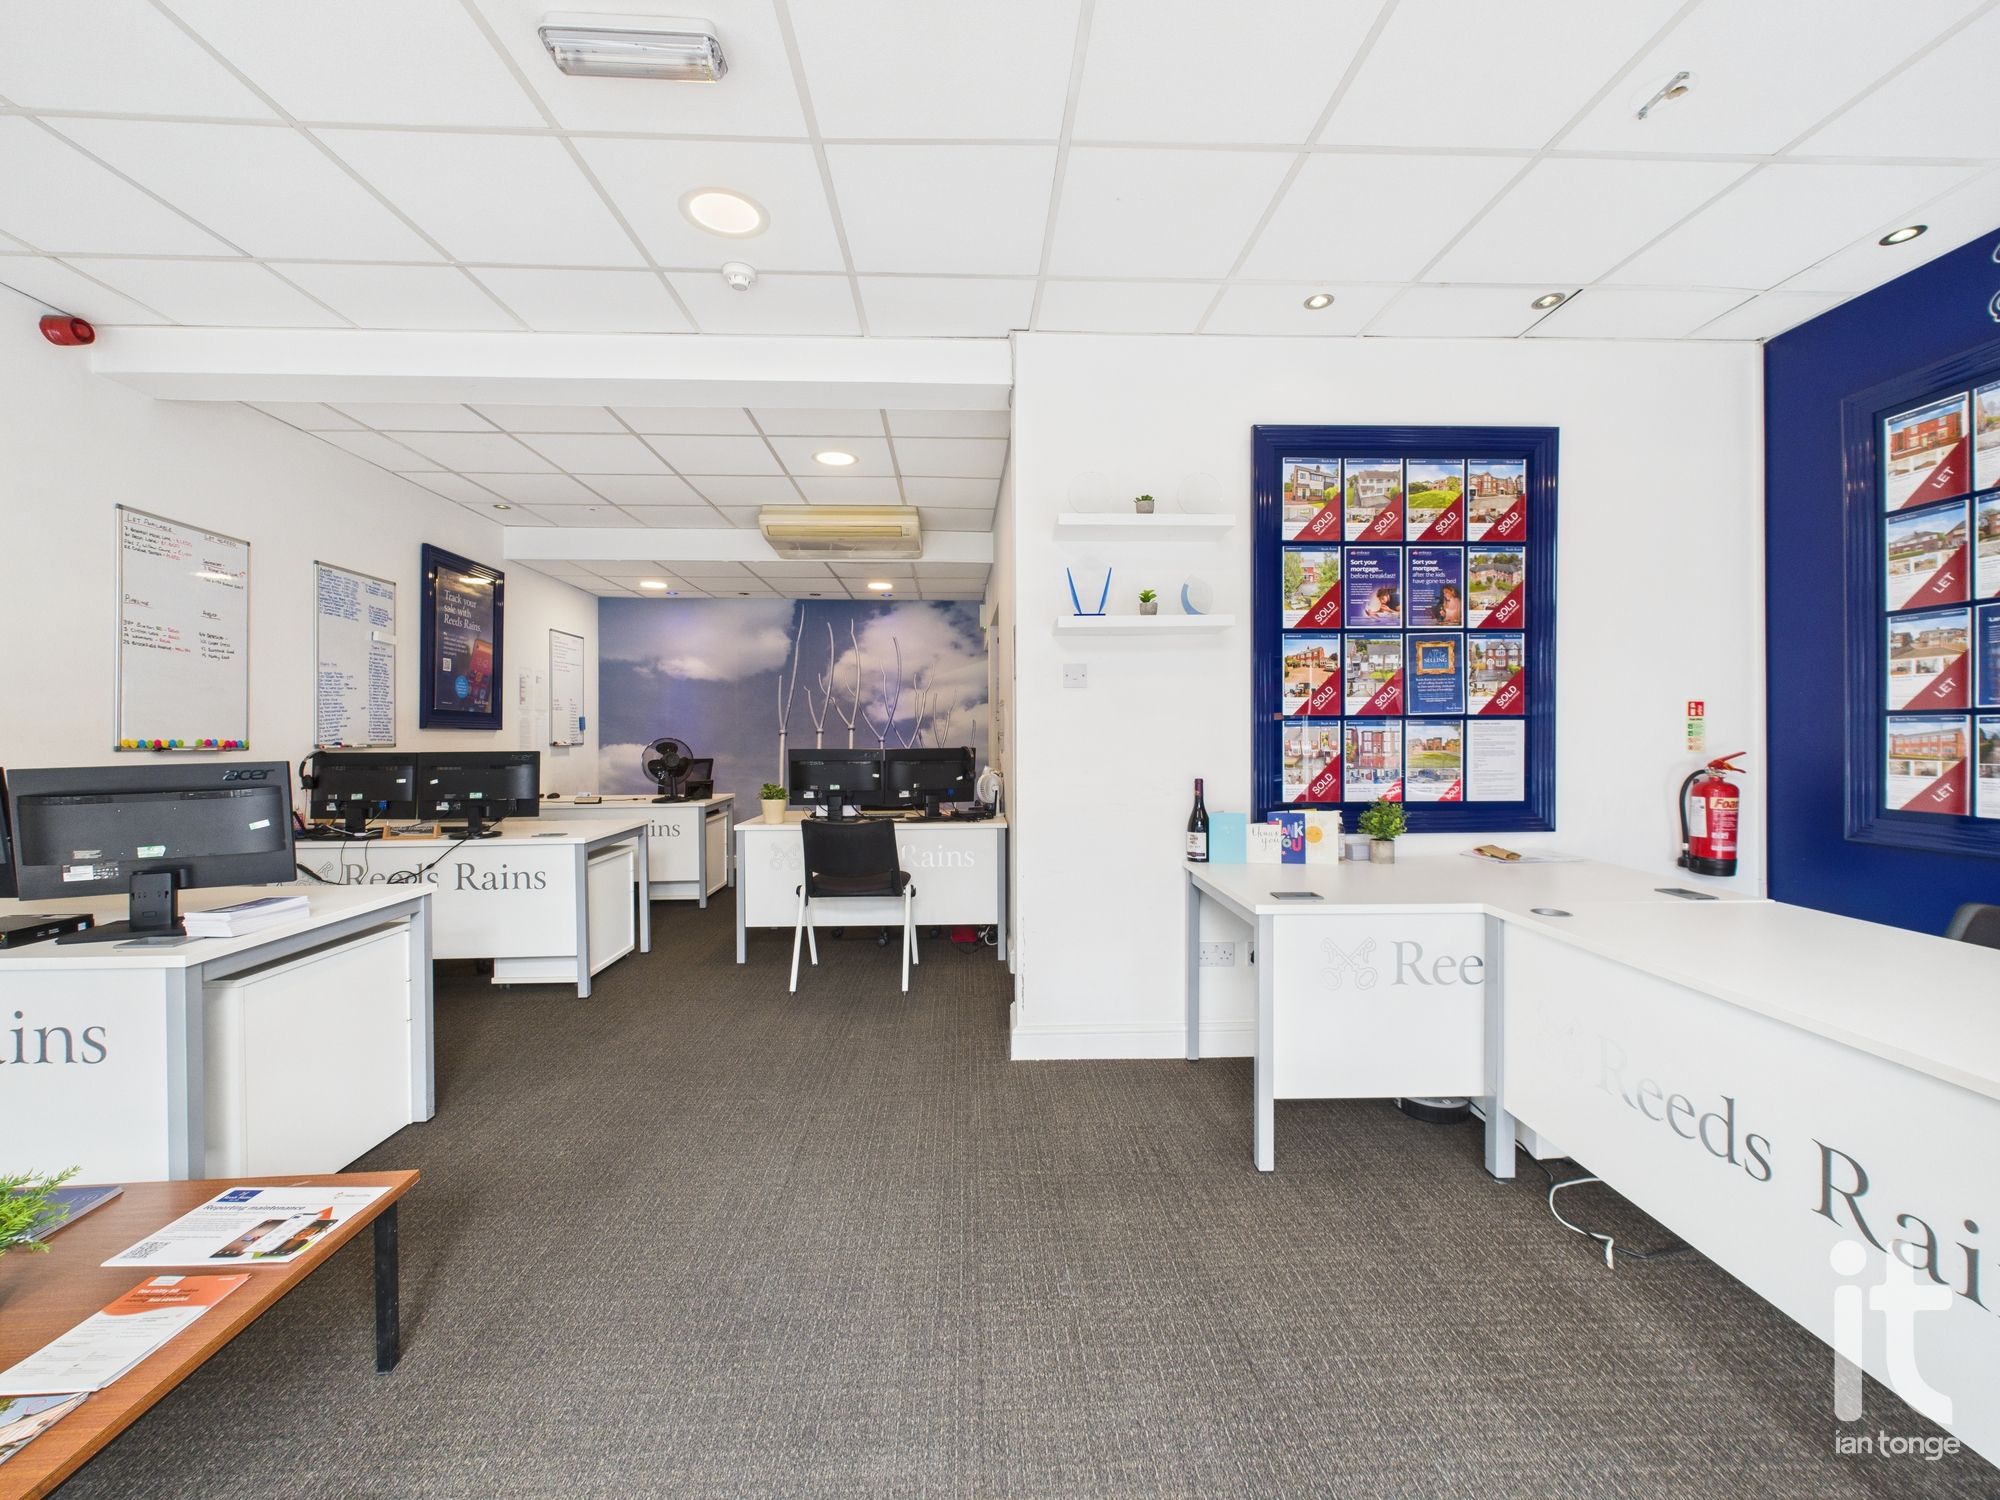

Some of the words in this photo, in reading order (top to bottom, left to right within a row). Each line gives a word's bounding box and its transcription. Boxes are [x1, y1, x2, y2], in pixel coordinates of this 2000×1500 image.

[1932, 466, 1954, 488] LET
[1312, 511, 1333, 533] SOLD
[1374, 511, 1395, 533] SOLD
[1435, 511, 1456, 533] SOLD
[1497, 511, 1519, 533] SOLD
[1932, 571, 1955, 593] LET
[444, 590, 462, 604] Track
[462, 598, 477, 609] your
[1495, 599, 1517, 621] SOLD
[443, 613, 463, 628] Reeds
[457, 608, 472, 619] with
[1314, 601, 1336, 623] SOLD
[1312, 686, 1333, 708] SOLD
[1374, 685, 1396, 708] SOLD
[1496, 685, 1517, 707] SOLD
[1933, 677, 1957, 698] LET
[223, 768, 275, 782] acer
[1312, 773, 1333, 795] SOLD
[1931, 783, 1954, 802] LET
[648, 820, 681, 838] ins
[902, 848, 976, 868] Rains
[456, 863, 547, 890] Rains
[0, 1010, 107, 1065] ins
[1594, 1034, 1773, 1183] Reeds
[1810, 1136, 2000, 1319] Rai
